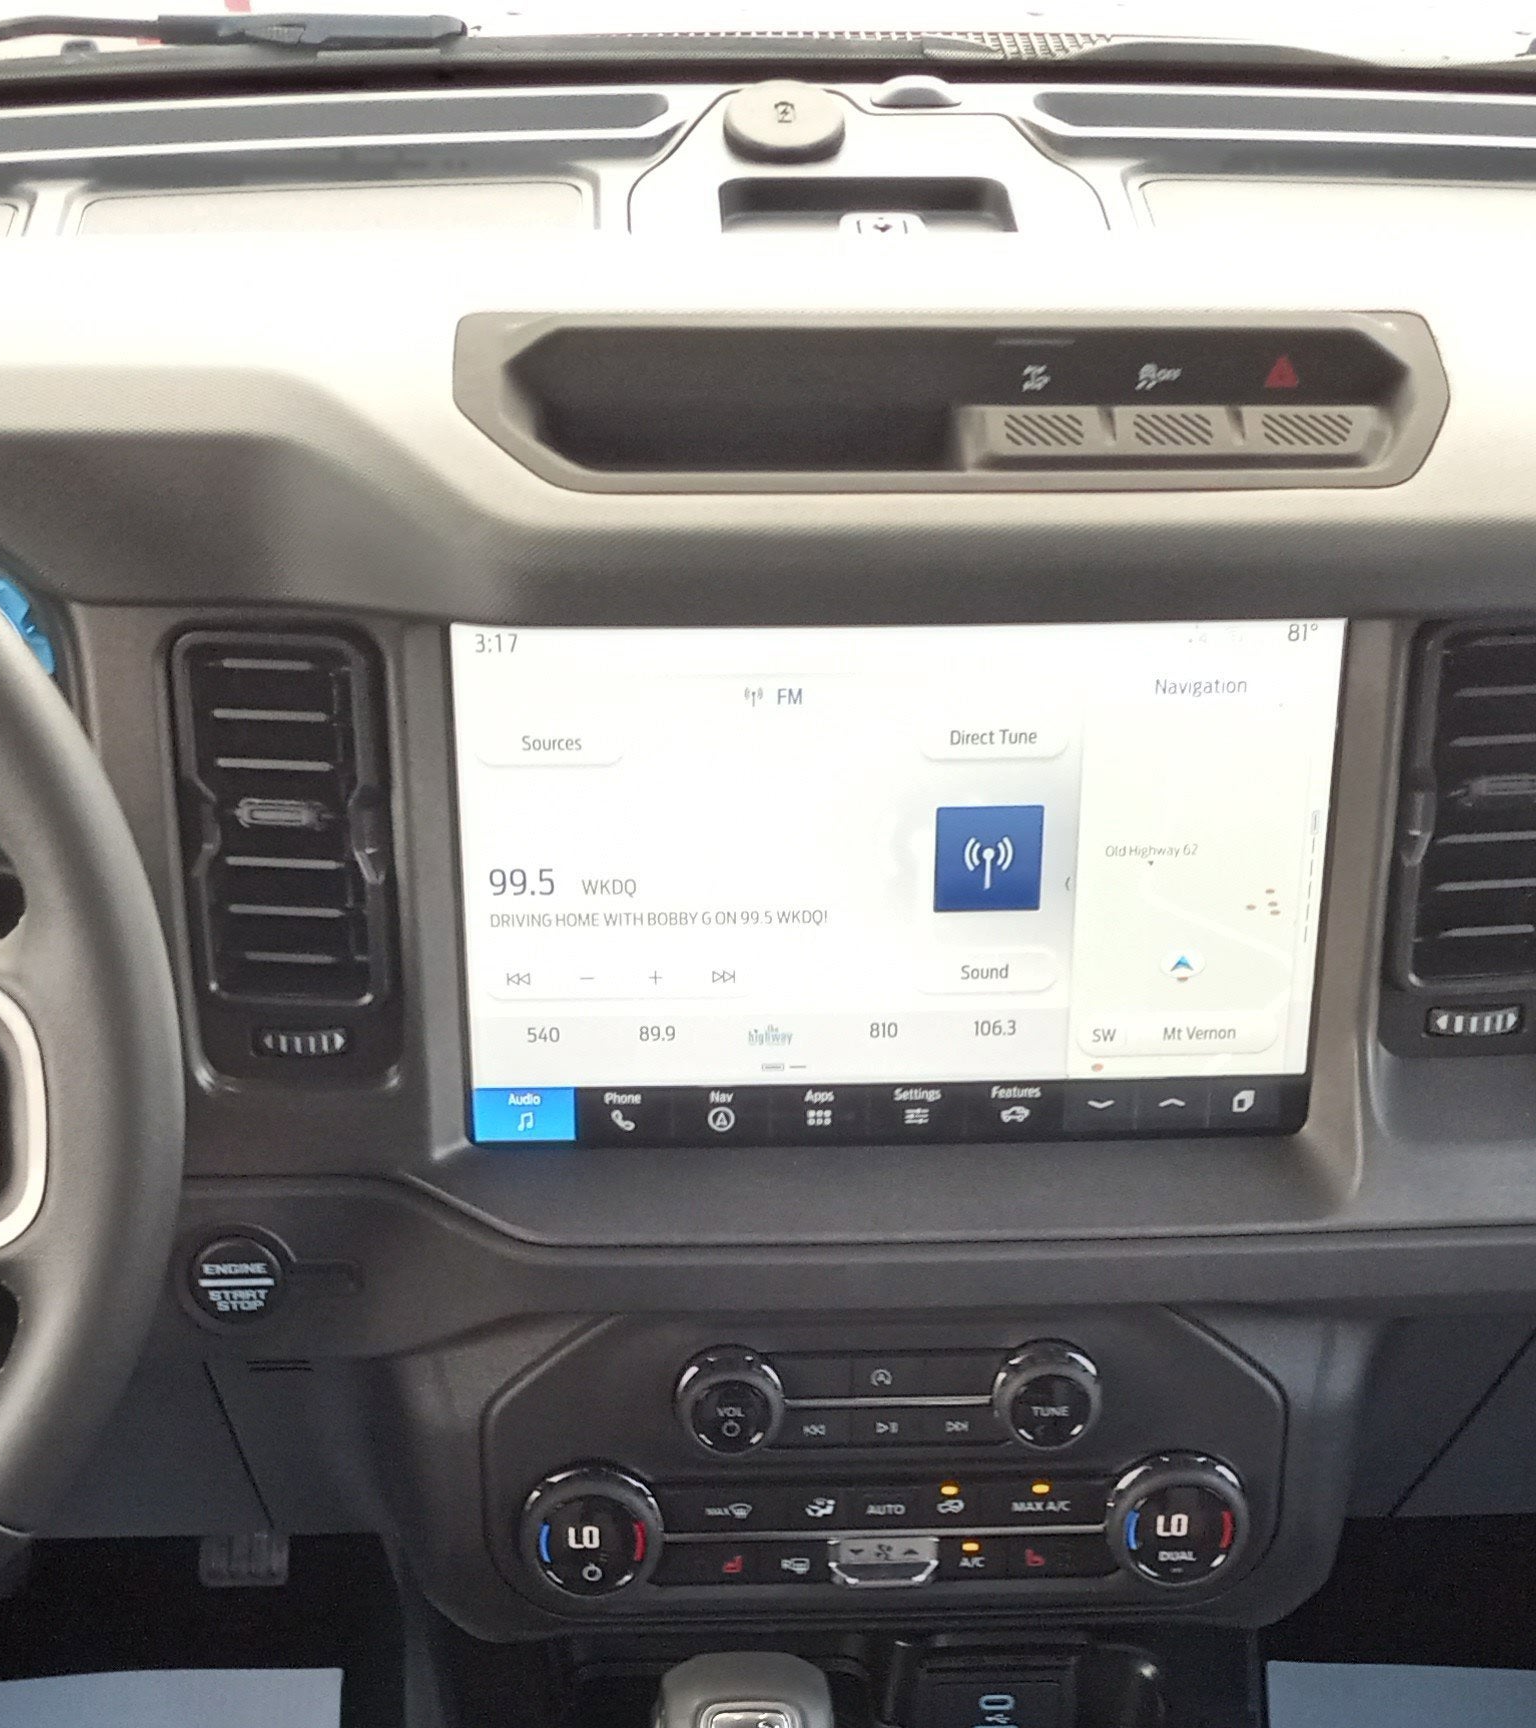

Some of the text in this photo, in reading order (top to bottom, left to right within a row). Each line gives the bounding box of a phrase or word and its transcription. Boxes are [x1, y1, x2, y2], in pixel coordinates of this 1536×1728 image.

[475, 633, 519, 654] 3:17
[1155, 678, 1247, 698] Navigation
[777, 688, 803, 705] FM
[521, 734, 582, 751] Sources
[949, 728, 1038, 746] Direct Tune
[1105, 843, 1199, 859] Old Highway 62
[489, 868, 637, 898] 99.5 WKDQ
[490, 909, 828, 928] DRIVING HOME WITH BOBBY G ON 99.5 WKDQ!
[961, 963, 1009, 980] Sound
[527, 1026, 675, 1043] 540 89.9
[870, 1021, 1017, 1038] 810 106.3
[1092, 1026, 1236, 1043] SW Mt Vernon
[508, 1093, 541, 1106] Audio
[604, 1092, 641, 1105] Phone
[709, 1090, 733, 1103] Nav
[804, 1089, 834, 1105] Apps
[893, 1088, 942, 1103] Settings
[991, 1085, 1041, 1099] Features
[202, 1262, 268, 1275] ENGINE
[208, 1289, 269, 1301] START
[217, 1300, 265, 1312] STOP
[716, 1407, 745, 1418] VOL
[1031, 1406, 1070, 1418] TUNE
[866, 1503, 906, 1516] AUTO
[1011, 1500, 1071, 1513] MAX A/C
[1156, 1513, 1189, 1537] LO
[568, 1525, 600, 1549] LO
[959, 1556, 985, 1568] A/C
[1158, 1550, 1197, 1562] DUAL
